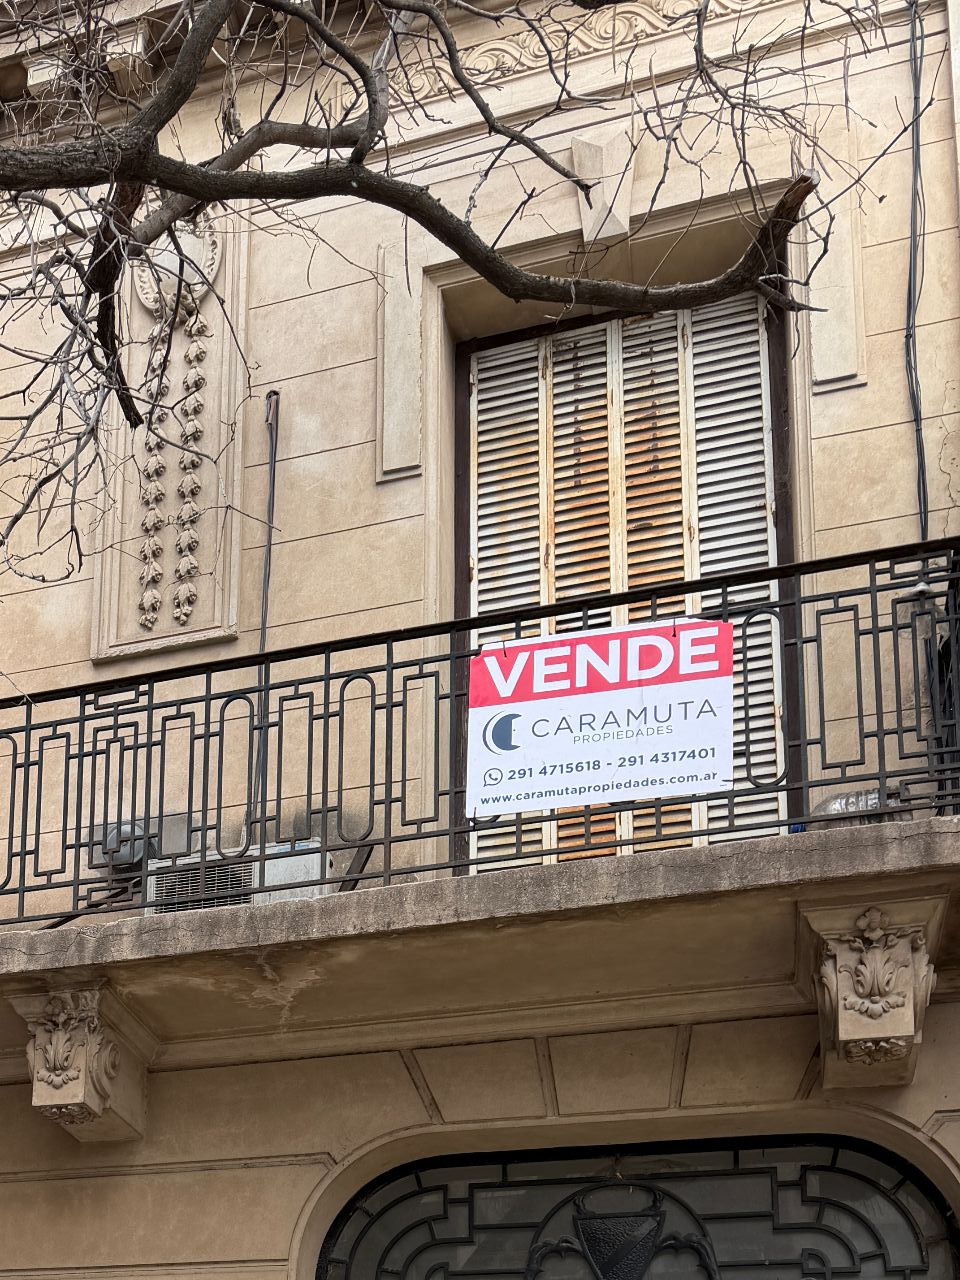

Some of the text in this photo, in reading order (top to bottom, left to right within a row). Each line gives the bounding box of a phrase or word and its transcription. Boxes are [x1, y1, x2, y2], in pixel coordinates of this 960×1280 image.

[483, 626, 719, 698] VENDE
[531, 698, 718, 738] CARAMUTA
[573, 724, 673, 745] PROPIEDADES
[507, 767, 534, 781] 291
[539, 759, 601, 776] 4715618
[618, 755, 645, 768] 291
[650, 747, 717, 764] 4317401
[480, 772, 718, 805] www.caramutapropiedades.com.ar
